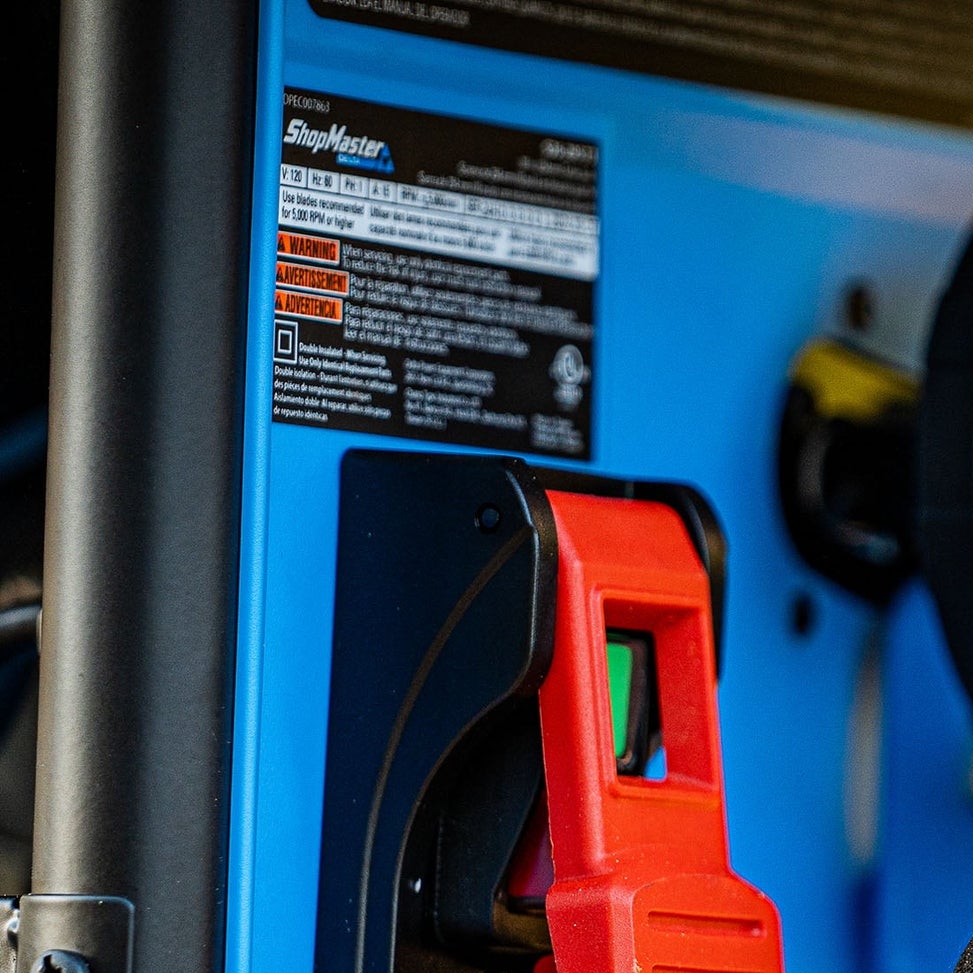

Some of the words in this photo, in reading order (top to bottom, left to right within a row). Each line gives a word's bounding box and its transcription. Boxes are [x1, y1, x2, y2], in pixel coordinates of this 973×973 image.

[283, 118, 385, 158] ShopMaster
[281, 166, 288, 180] V:
[290, 169, 302, 182] 120
[282, 190, 295, 203] Use
[296, 192, 317, 207] blades
[319, 198, 365, 214] recommended
[281, 205, 292, 218] for
[292, 208, 309, 222] 5,000
[310, 210, 325, 224] RPM
[326, 216, 333, 225] or
[335, 215, 354, 230] higher
[290, 235, 337, 261] WARNING
[285, 265, 347, 292] AVERTISSEMENT
[286, 294, 337, 319] ADVERTENCIA
[299, 342, 317, 354] Double
[299, 356, 308, 366] Use
[309, 358, 321, 369] Only
[274, 366, 292, 376] Double
[294, 368, 315, 381] isolation
[274, 379, 283, 389] des
[284, 381, 300, 392] pièces
[301, 383, 307, 391] de
[273, 392, 303, 405] Aislamiento
[273, 406, 280, 415] de
[281, 408, 303, 420] repuesto
